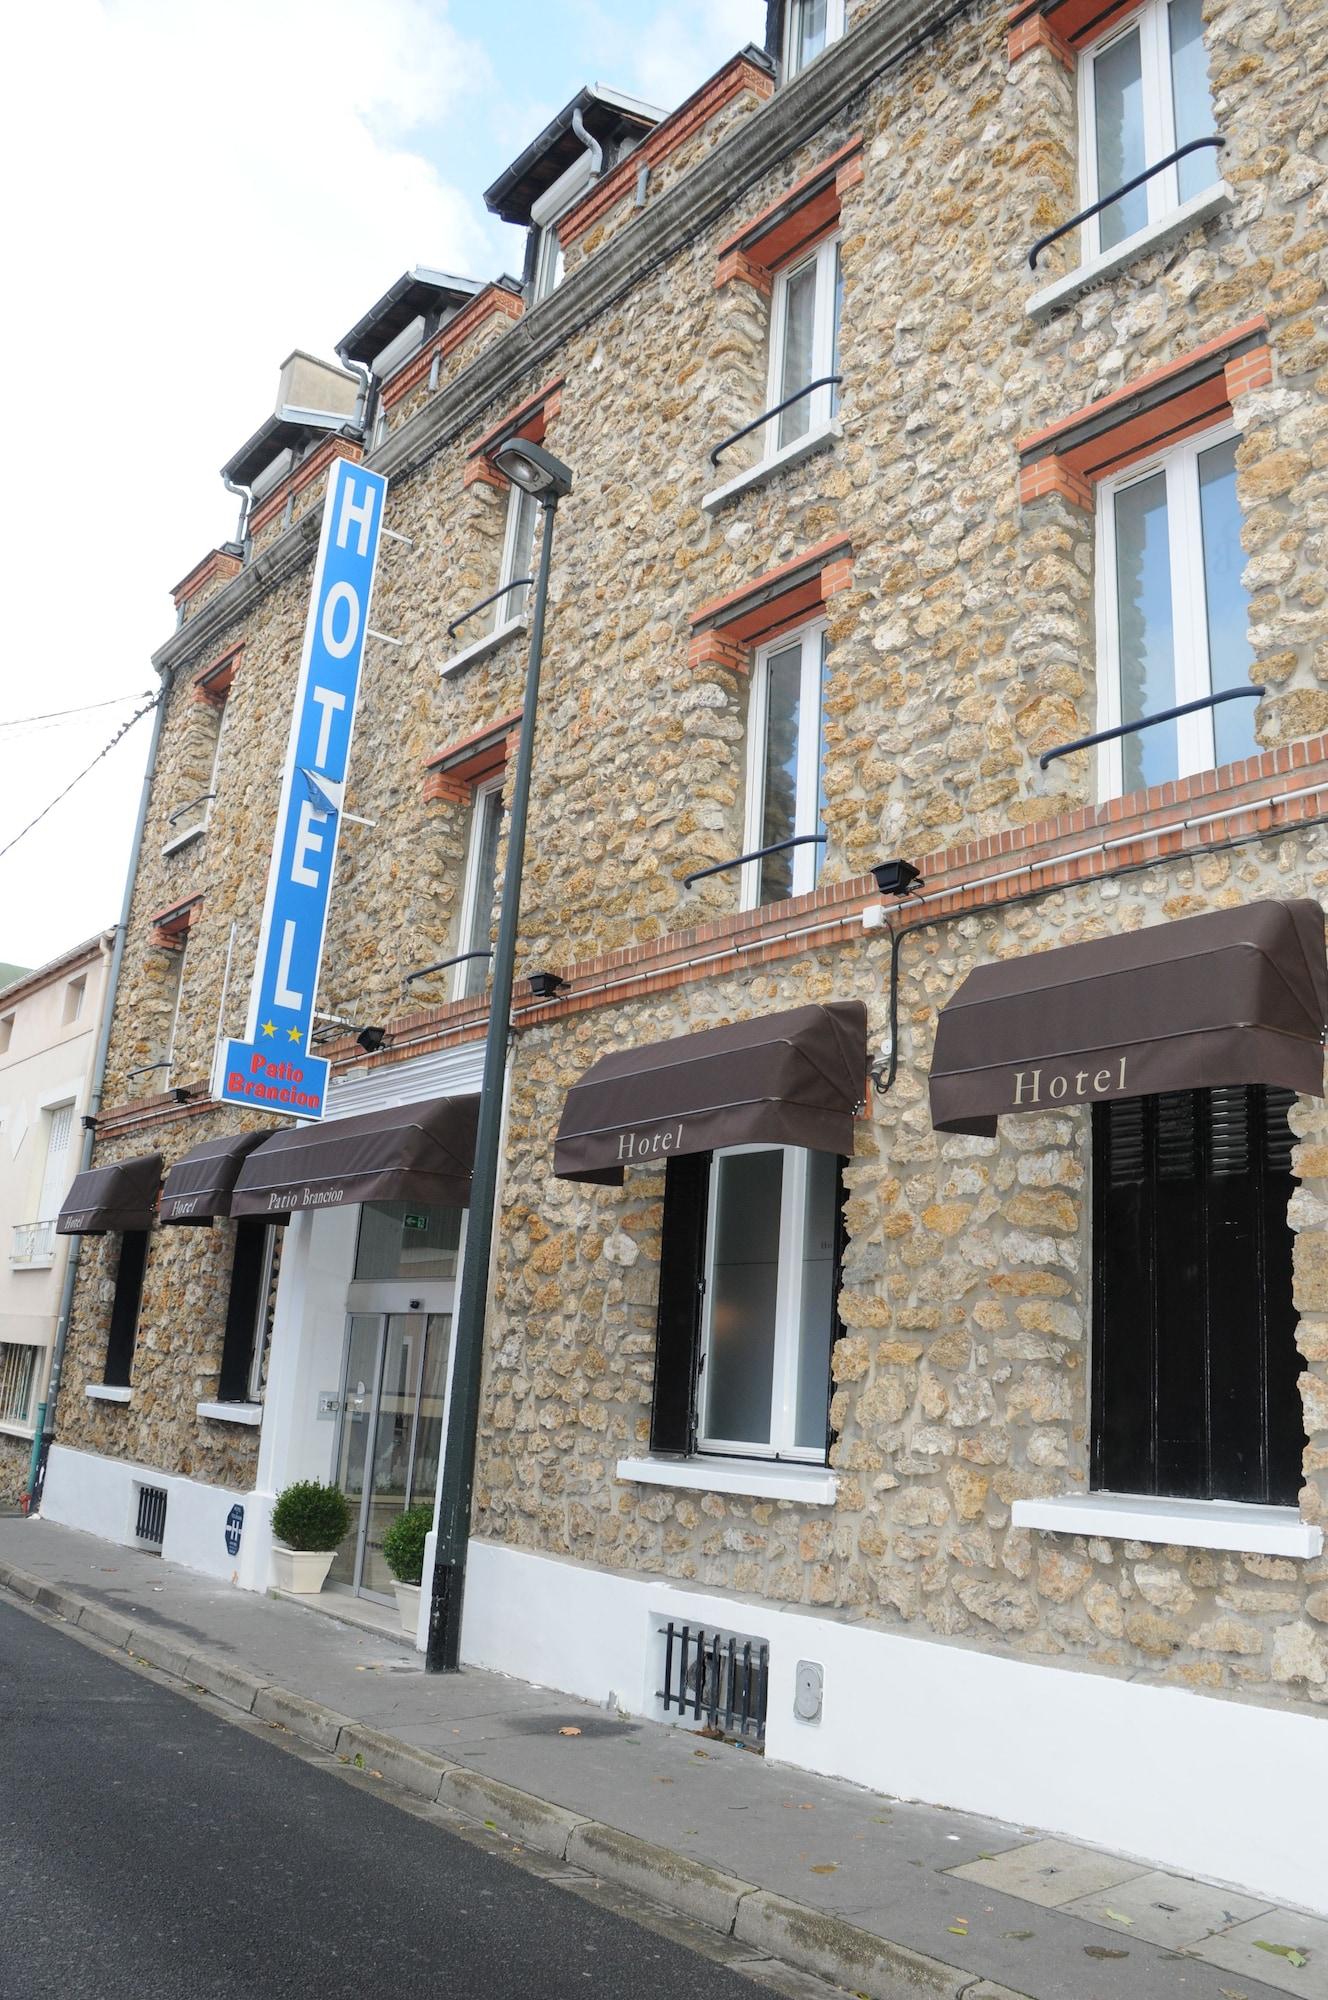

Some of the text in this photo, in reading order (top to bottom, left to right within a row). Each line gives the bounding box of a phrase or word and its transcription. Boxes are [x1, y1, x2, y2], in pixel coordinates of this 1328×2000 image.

[275, 477, 376, 1010] HOTEL
[250, 1053, 303, 1082] Patio
[1012, 1056, 1127, 1105] Hotel
[227, 1072, 320, 1109] Brancion
[616, 1123, 683, 1160] Hotel
[171, 1198, 198, 1216] Hotel
[267, 1187, 344, 1210] Patio Brancion
[65, 1214, 84, 1229] Hotel
